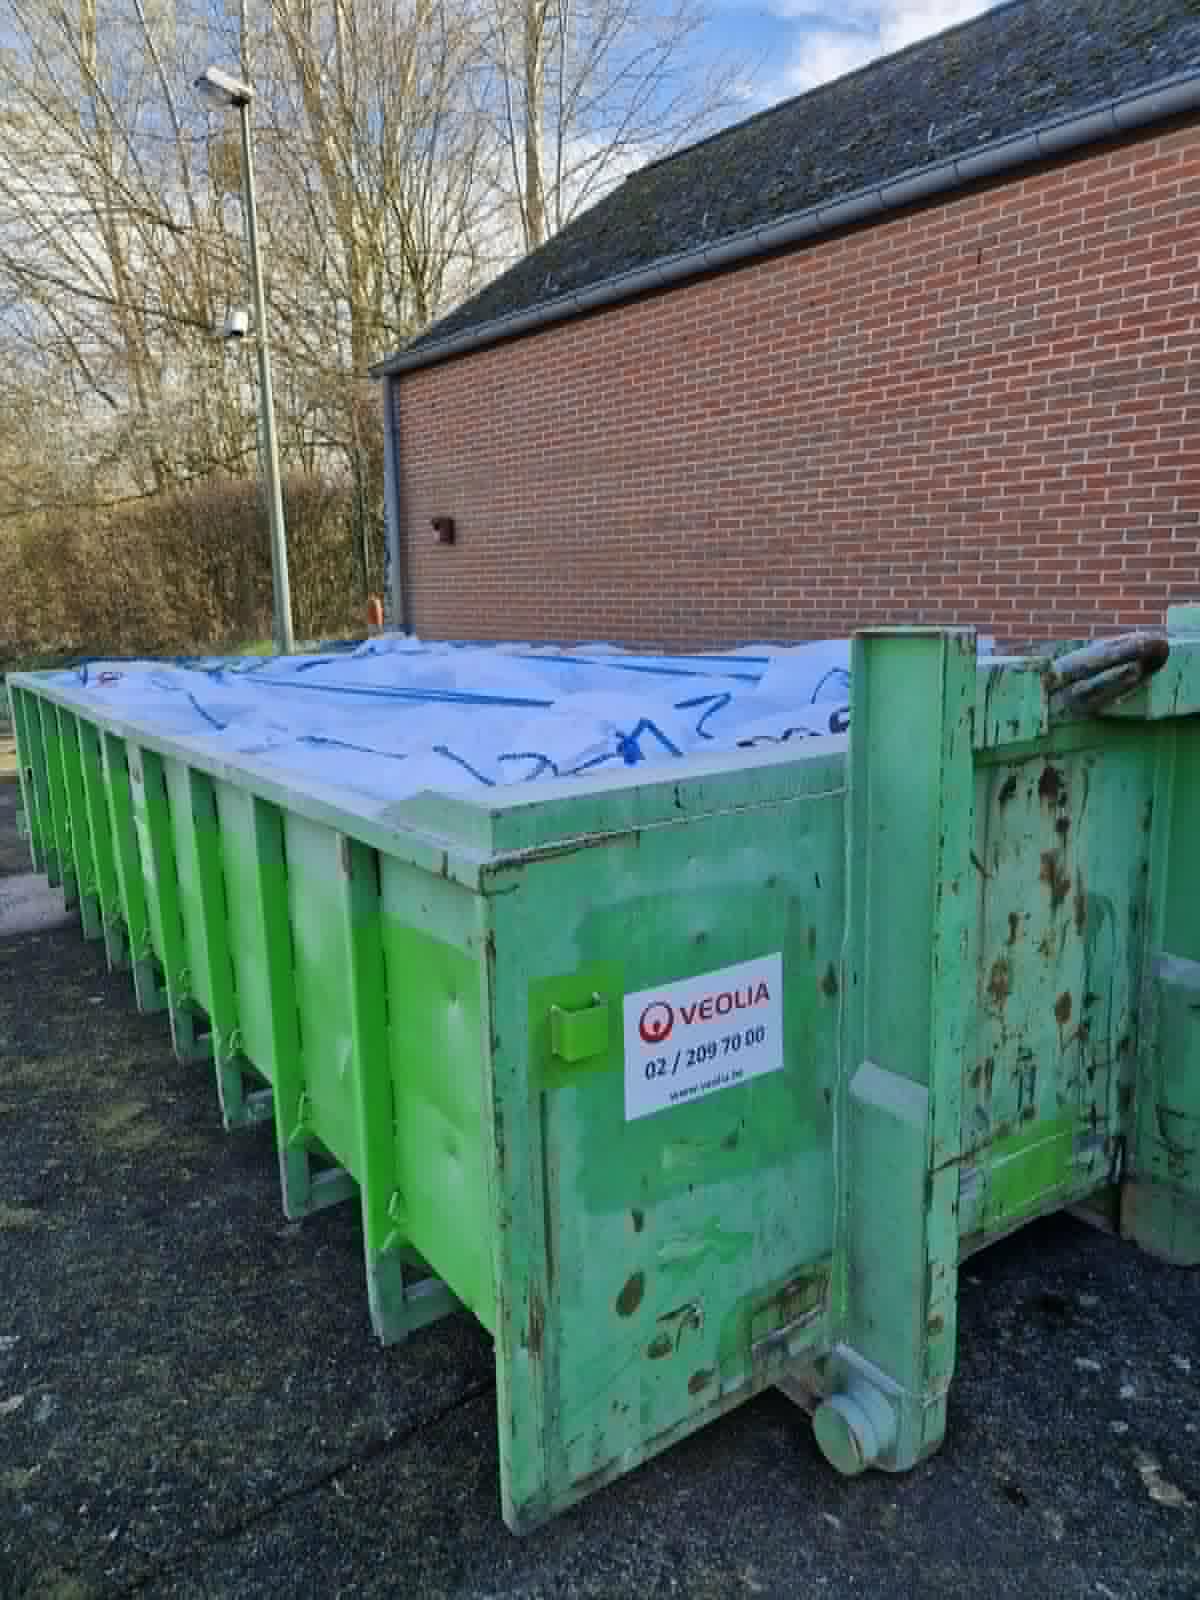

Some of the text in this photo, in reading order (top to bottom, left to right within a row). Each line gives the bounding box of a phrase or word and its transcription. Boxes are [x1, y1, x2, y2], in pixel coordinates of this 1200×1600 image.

[680, 983, 770, 1025] VEOLIA
[645, 1024, 765, 1080] 02 / 209 70 00
